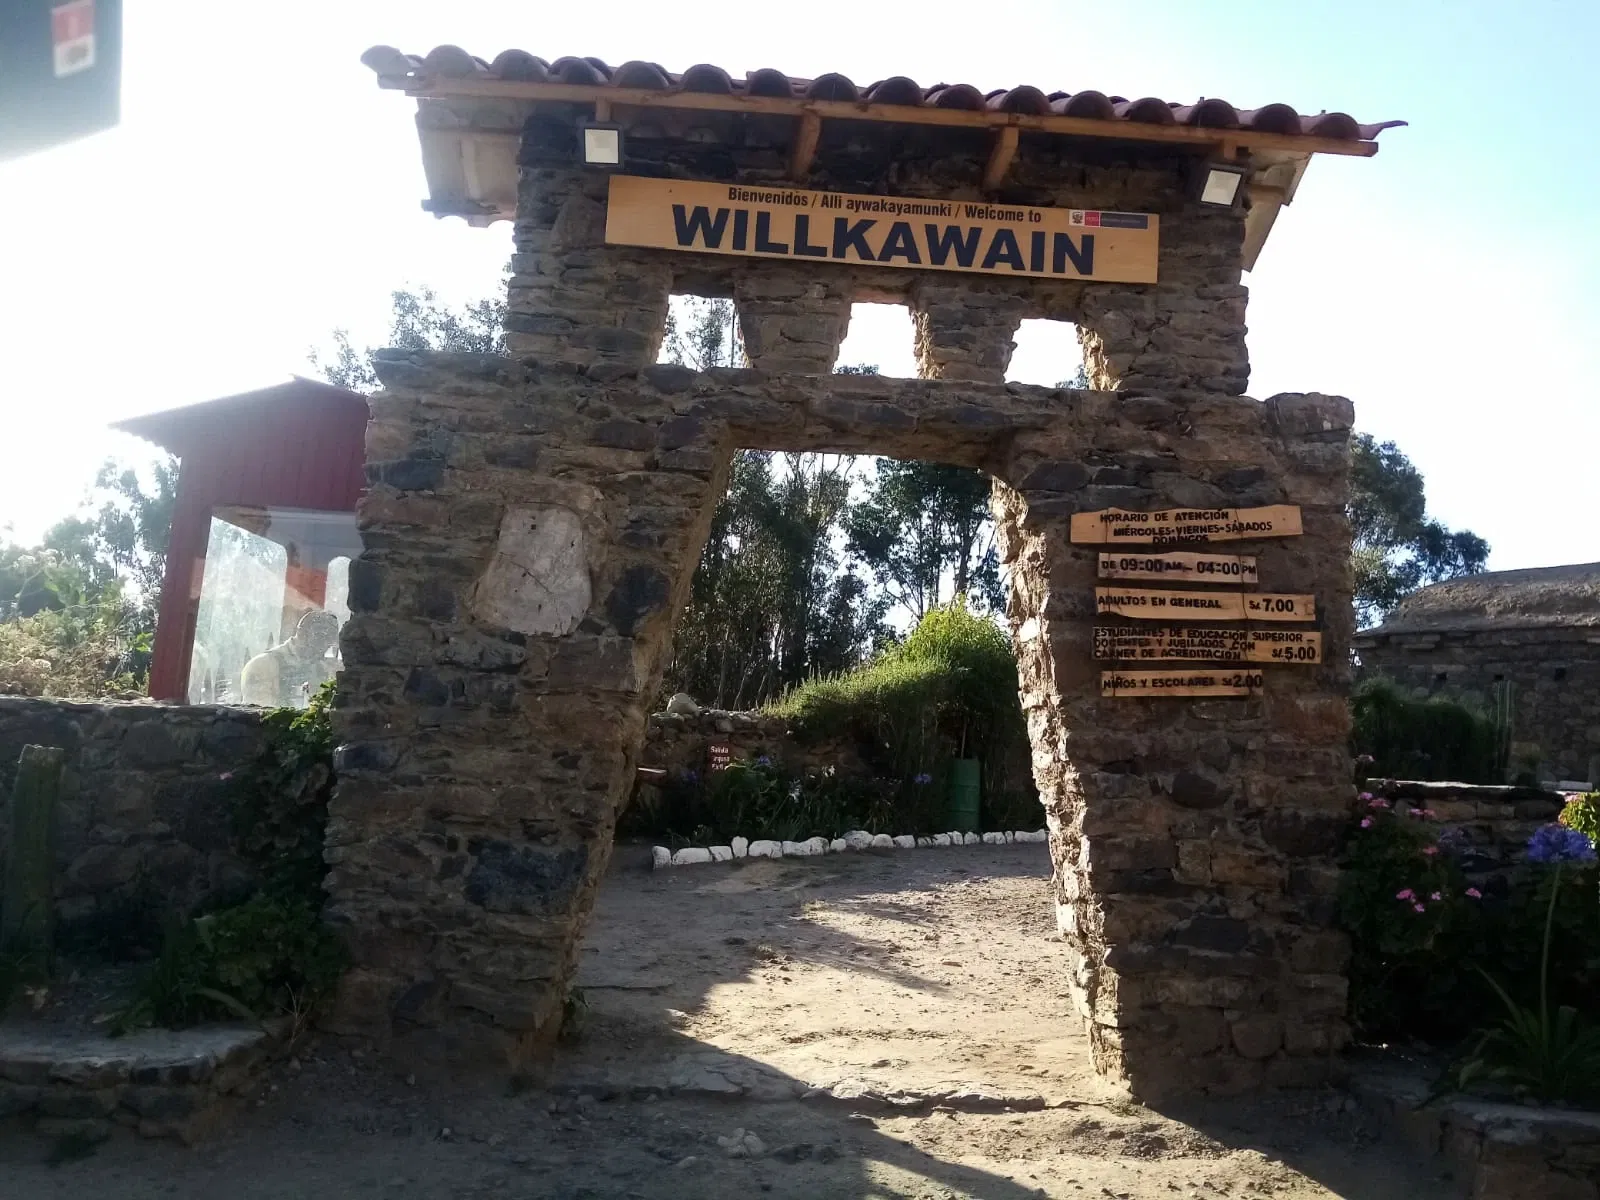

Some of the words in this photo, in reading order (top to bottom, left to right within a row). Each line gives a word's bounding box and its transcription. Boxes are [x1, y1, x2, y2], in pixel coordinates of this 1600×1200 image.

[728, 187, 808, 206] Bienvenidos
[821, 195, 842, 209] Alli
[846, 197, 952, 217] aywakayamunki
[965, 205, 1024, 222] Welcome
[1029, 211, 1042, 223] to
[672, 204, 1095, 275] WILLKAWAIN
[1100, 513, 1148, 523] HORARIO
[1154, 513, 1169, 521] DE
[1101, 561, 1116, 569] DE
[1098, 596, 1146, 606] ADULTOS
[1150, 597, 1166, 606] EN
[1170, 598, 1222, 608] GENERAL
[1169, 628, 1182, 637] DE
[1252, 632, 1303, 642] SUPERIOR
[1156, 638, 1165, 647] Y
[1141, 649, 1156, 657] DE
[1140, 678, 1148, 688] Y
